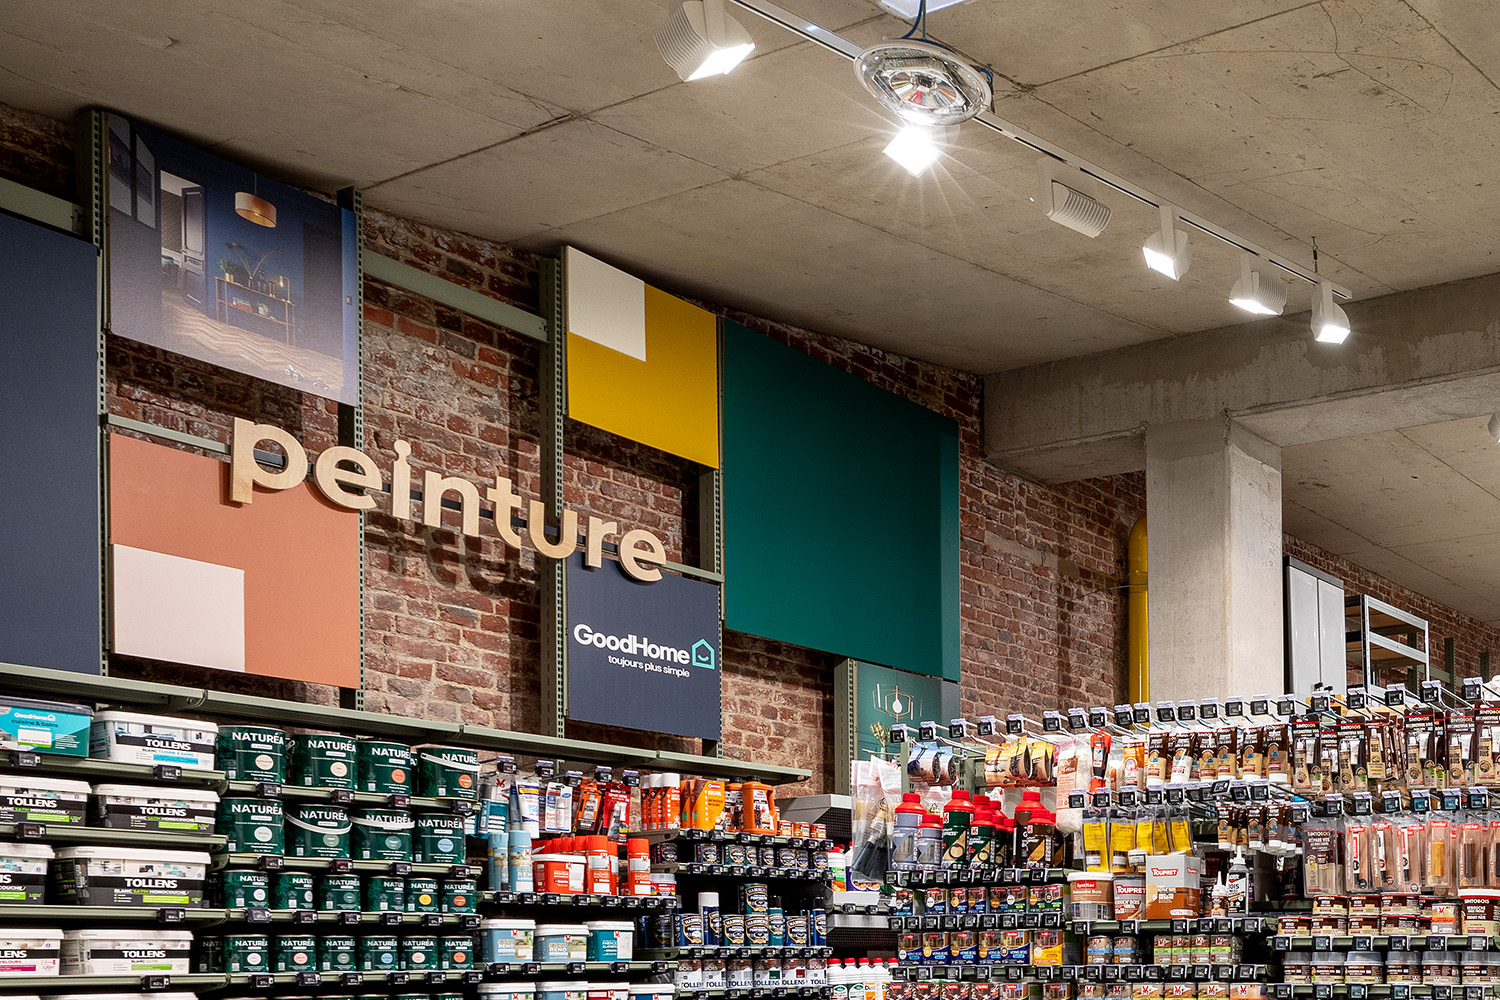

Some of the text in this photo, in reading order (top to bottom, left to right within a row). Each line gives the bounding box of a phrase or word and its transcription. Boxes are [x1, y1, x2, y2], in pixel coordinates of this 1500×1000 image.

[230, 417, 667, 582] peinture
[573, 624, 690, 664] GoodHome
[608, 655, 690, 678] toujours plus simple
[146, 738, 192, 751] TOLLENS
[371, 747, 411, 760] NATURÉ
[7, 797, 58, 809] TOLLENS
[140, 806, 187, 817] TOLLENS
[1152, 868, 1178, 877] TOUPRET
[125, 878, 178, 889] TOLLENS
[122, 951, 166, 959] TOLLENS
